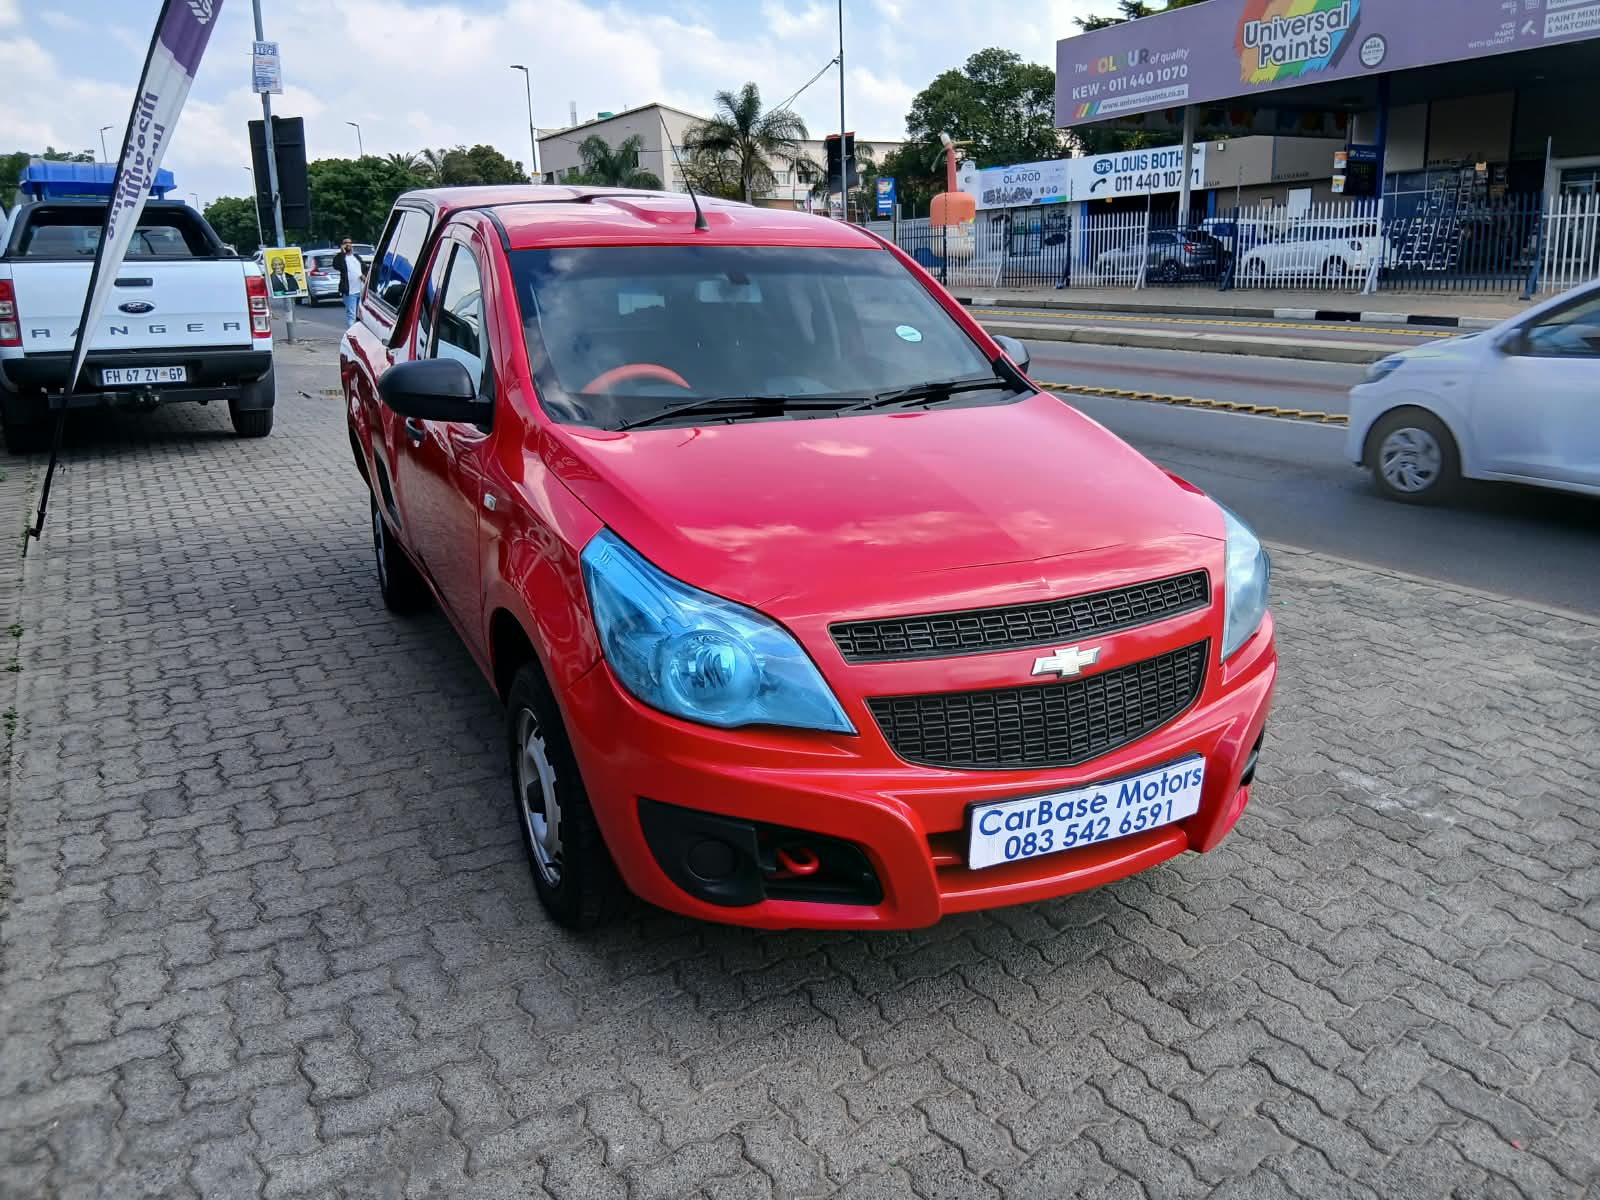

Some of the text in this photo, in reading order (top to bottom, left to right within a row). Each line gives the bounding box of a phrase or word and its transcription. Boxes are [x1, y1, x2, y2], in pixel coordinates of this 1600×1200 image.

[1245, 4, 1349, 46] Universal
[1548, 12, 1576, 24] PAINT
[1074, 47, 1190, 75] The COLOUR of quality
[1260, 33, 1329, 66] Paints
[1072, 82, 1100, 100] KEW
[1109, 78, 1127, 92] 011
[1129, 71, 1154, 87] 440
[1157, 63, 1188, 82] 1070
[1114, 154, 1148, 173] LOUIS
[1151, 149, 1184, 169] BOTH
[1115, 175, 1133, 192] 011
[1136, 172, 1160, 190] 440
[31, 322, 241, 338] RNGER
[105, 367, 183, 383] FH 67 ZY GP
[979, 767, 1202, 836] CarBase Motors
[1004, 799, 1174, 860] 083 542 6591
